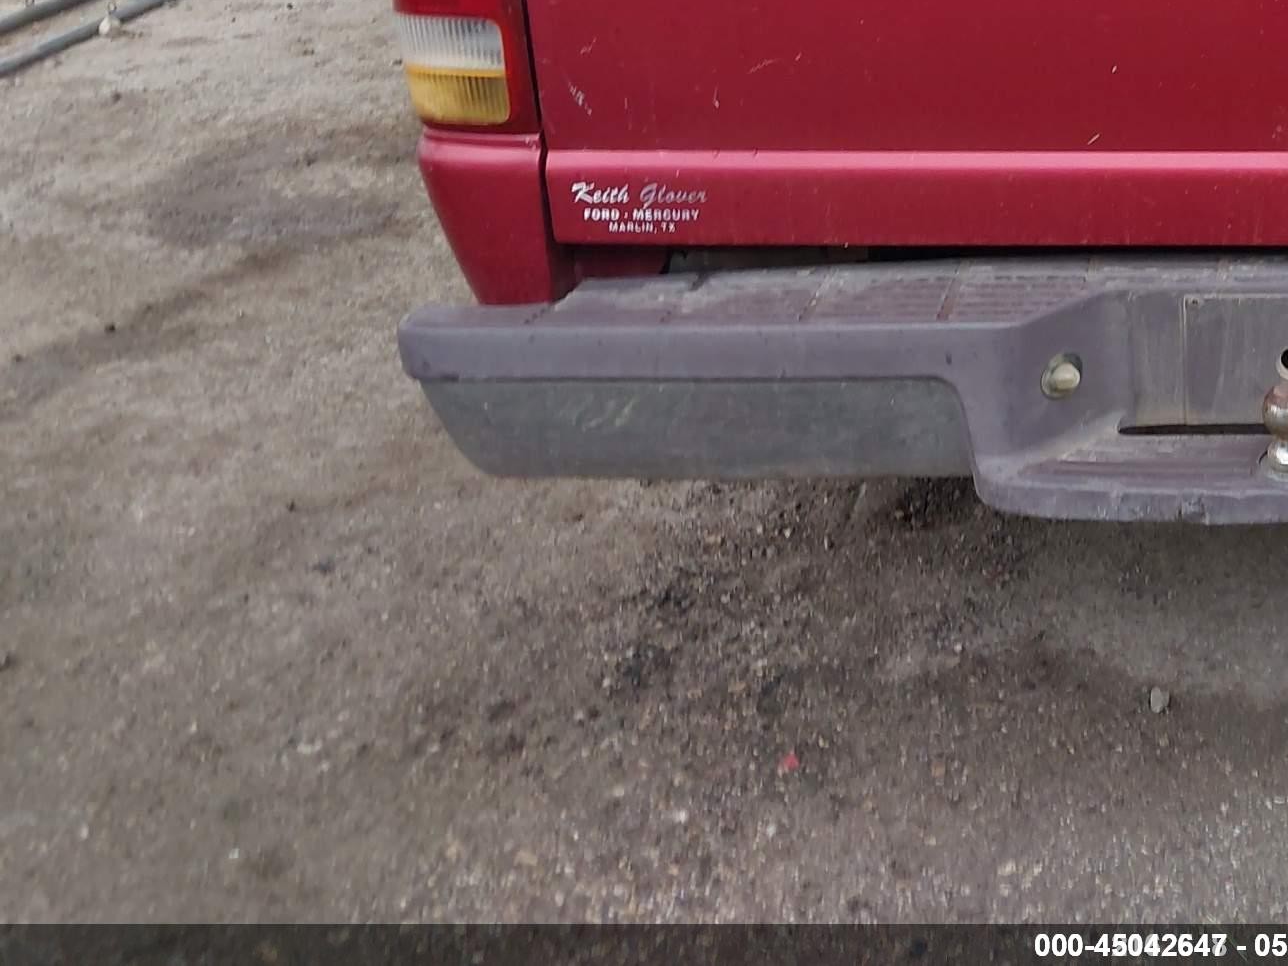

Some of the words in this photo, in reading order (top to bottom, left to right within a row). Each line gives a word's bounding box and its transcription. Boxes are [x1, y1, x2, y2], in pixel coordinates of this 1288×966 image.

[571, 181, 630, 204] Keith
[640, 182, 708, 209] Glover
[583, 207, 620, 222] FORD
[632, 207, 700, 222] MERCURY
